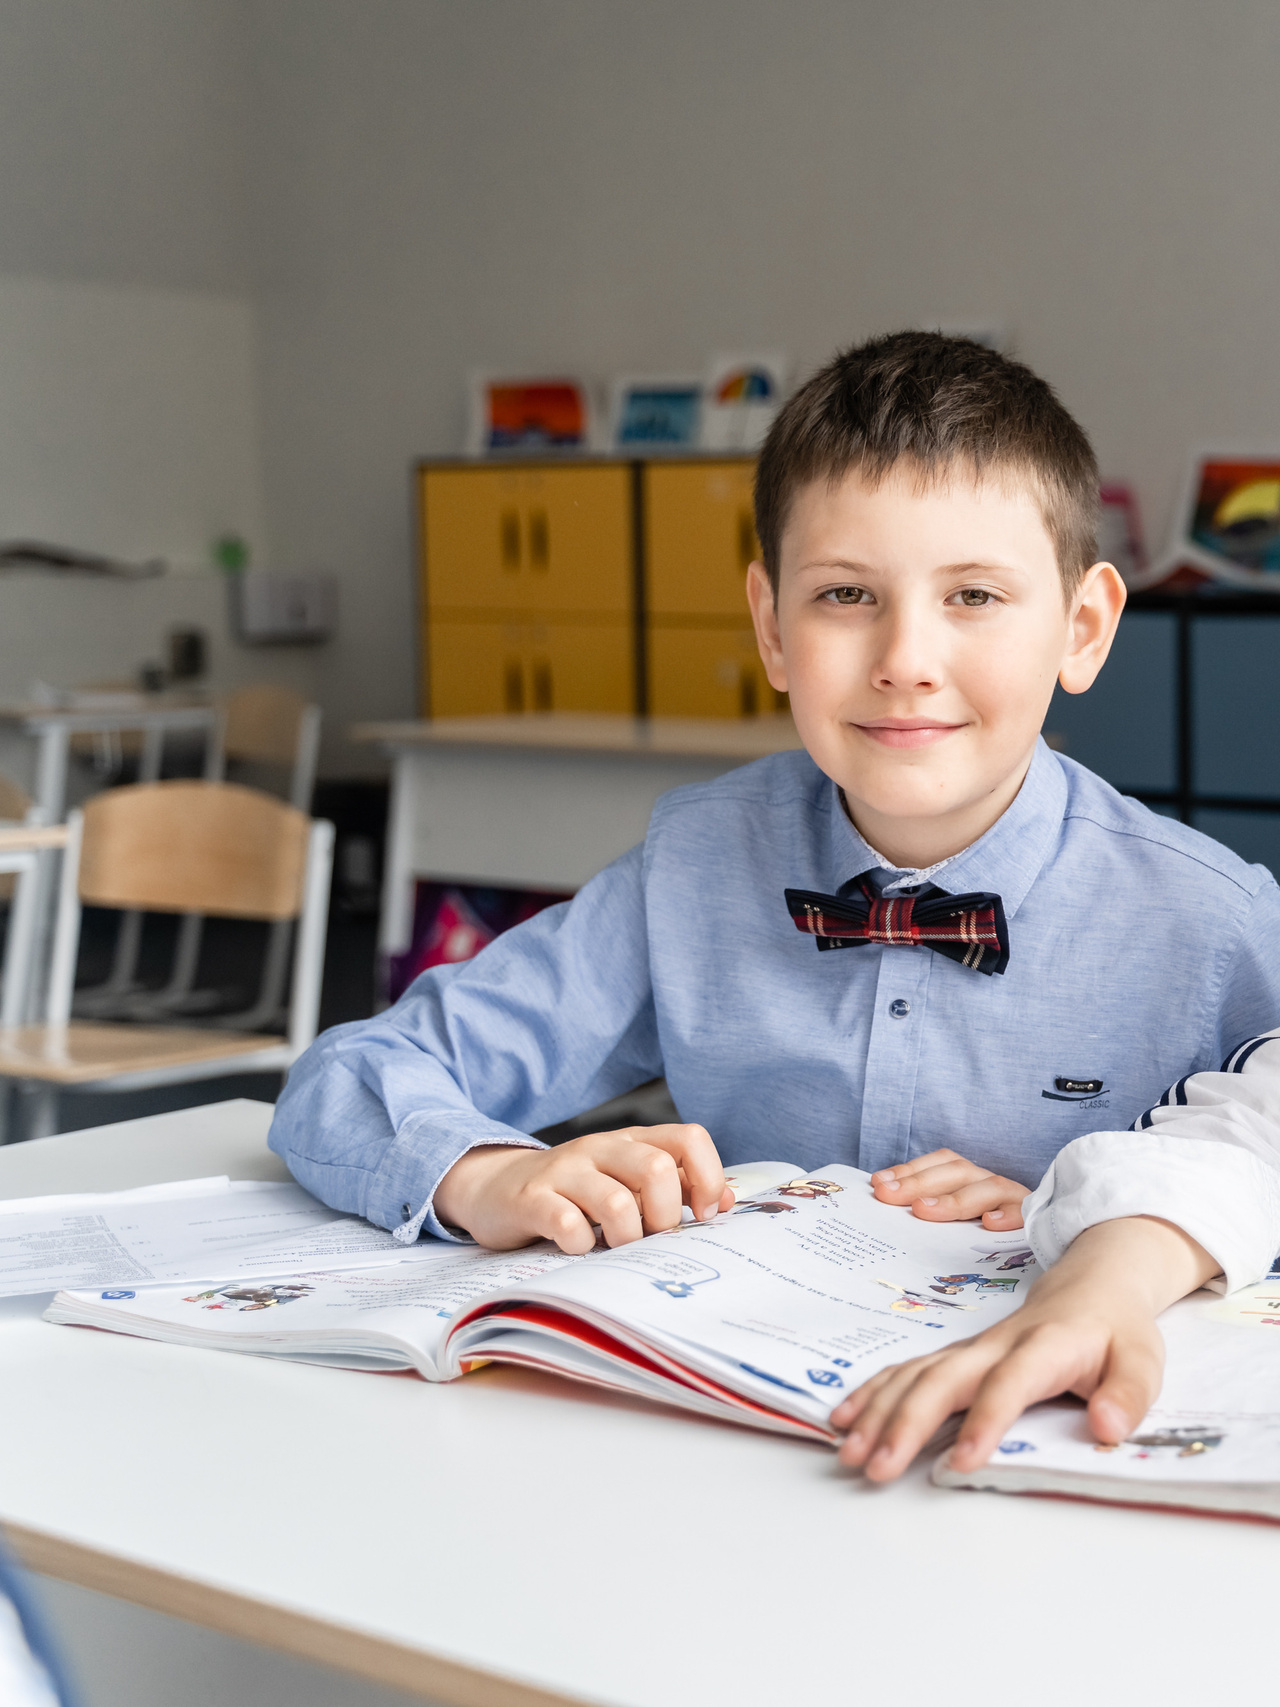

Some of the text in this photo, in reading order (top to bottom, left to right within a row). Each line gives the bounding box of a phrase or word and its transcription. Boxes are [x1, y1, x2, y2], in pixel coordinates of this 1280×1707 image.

[1079, 1099, 1110, 1110] CLASSIC
[829, 1217, 856, 1233] music
[784, 1226, 820, 1247] picture
[815, 1218, 888, 1254] play basketball
[815, 1226, 875, 1257] walk the dog
[809, 1232, 866, 1260] cook dinner
[870, 1237, 897, 1251] listen
[723, 1247, 745, 1258] and
[796, 1243, 842, 1266] watch TV
[829, 1249, 856, 1263] paint
[746, 1257, 771, 1272] Look
[771, 1272, 806, 1289] night?
[807, 1287, 827, 1297] last
[846, 1302, 871, 1311] they
[894, 1314, 923, 1324] What
